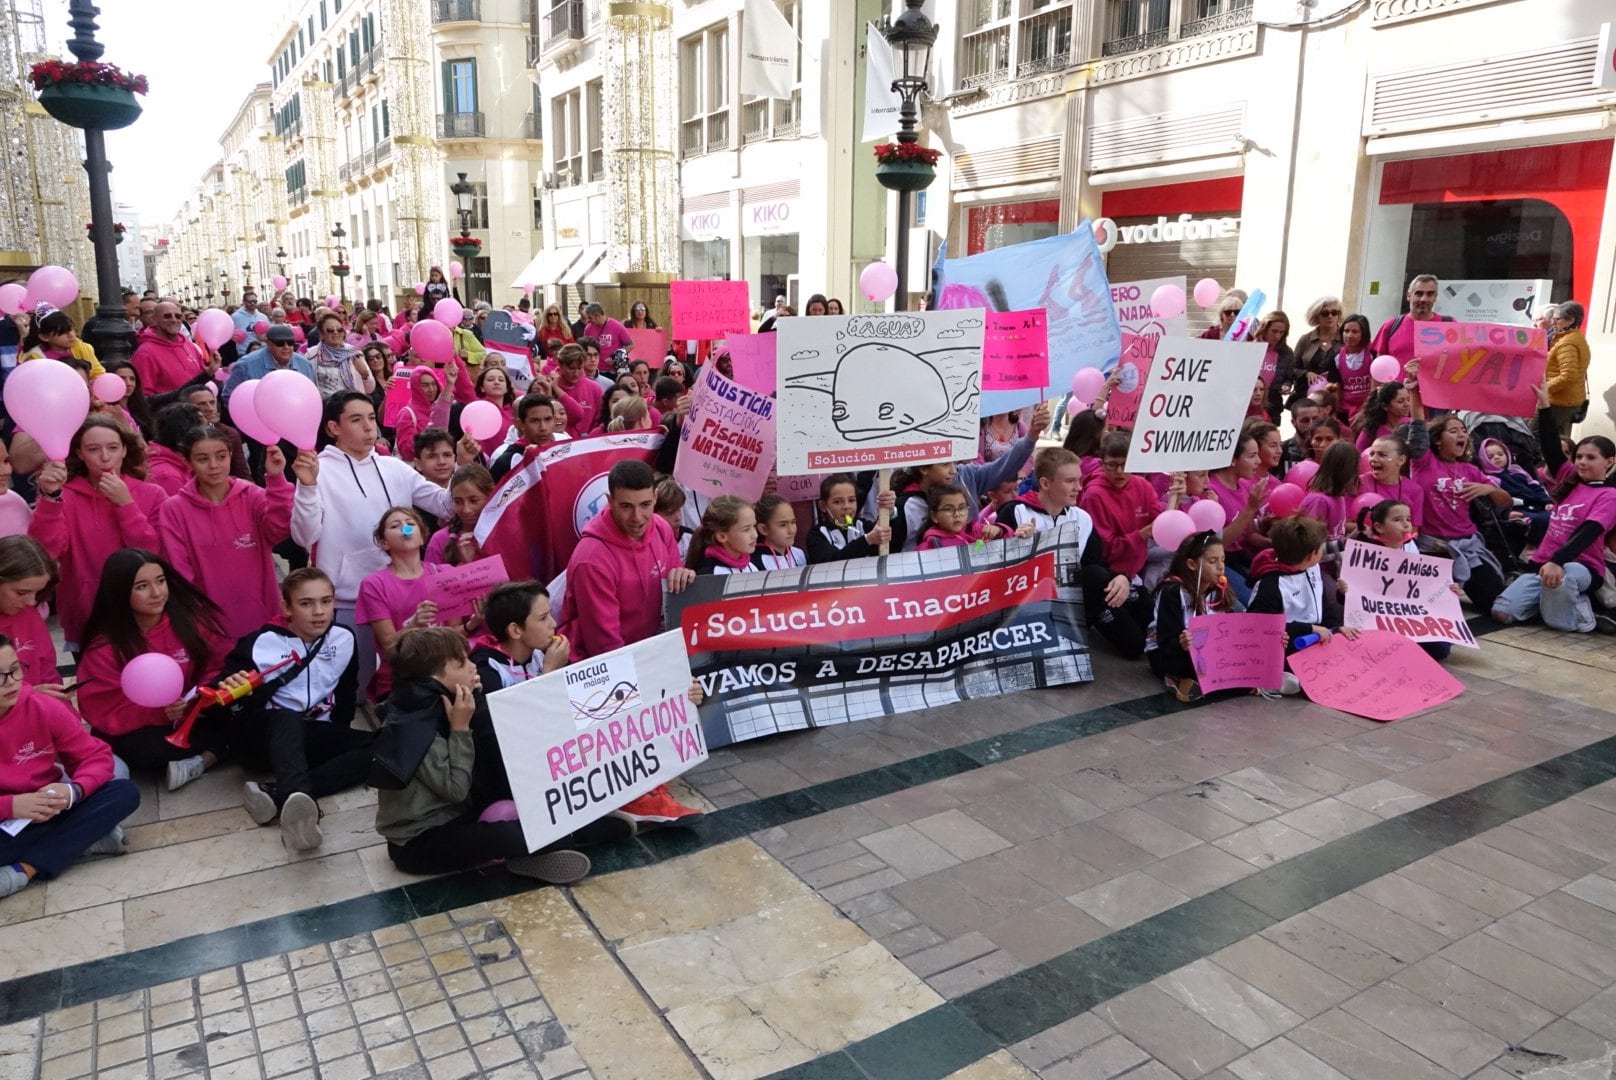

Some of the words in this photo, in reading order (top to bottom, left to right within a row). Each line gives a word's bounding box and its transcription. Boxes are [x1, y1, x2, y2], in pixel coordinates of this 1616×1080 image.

[691, 213, 720, 231] KIKO
[753, 203, 790, 223] KIKO
[1119, 213, 1237, 244] vodafone
[1110, 285, 1141, 303] ERO
[1119, 304, 1153, 322] NADA
[494, 321, 519, 331] RIP
[850, 317, 921, 335] ¡AGUA!
[1160, 357, 1212, 382] SAVE
[1150, 394, 1193, 418] OUR
[702, 418, 764, 454] PISCINAS
[1140, 429, 1235, 453] SWIMMERS
[808, 450, 876, 468] ¡Solución
[884, 448, 926, 460] Inacua
[932, 444, 952, 455] Ya!
[790, 479, 813, 491] CLUB
[1381, 576, 1394, 596] Y
[690, 603, 866, 645] ¡Solución
[884, 589, 990, 621] Inacua
[1004, 566, 1040, 596] Ya!
[1361, 595, 1429, 615] QUEREMOS
[699, 661, 797, 698] VAMOS
[816, 660, 838, 678] A
[856, 621, 1053, 675] DESAPARECER
[565, 662, 608, 685] inacua
[583, 674, 610, 689] málaga
[546, 689, 688, 782] REPARACIÓN
[545, 743, 660, 825] PISCINAS
[670, 724, 704, 763] YA!
